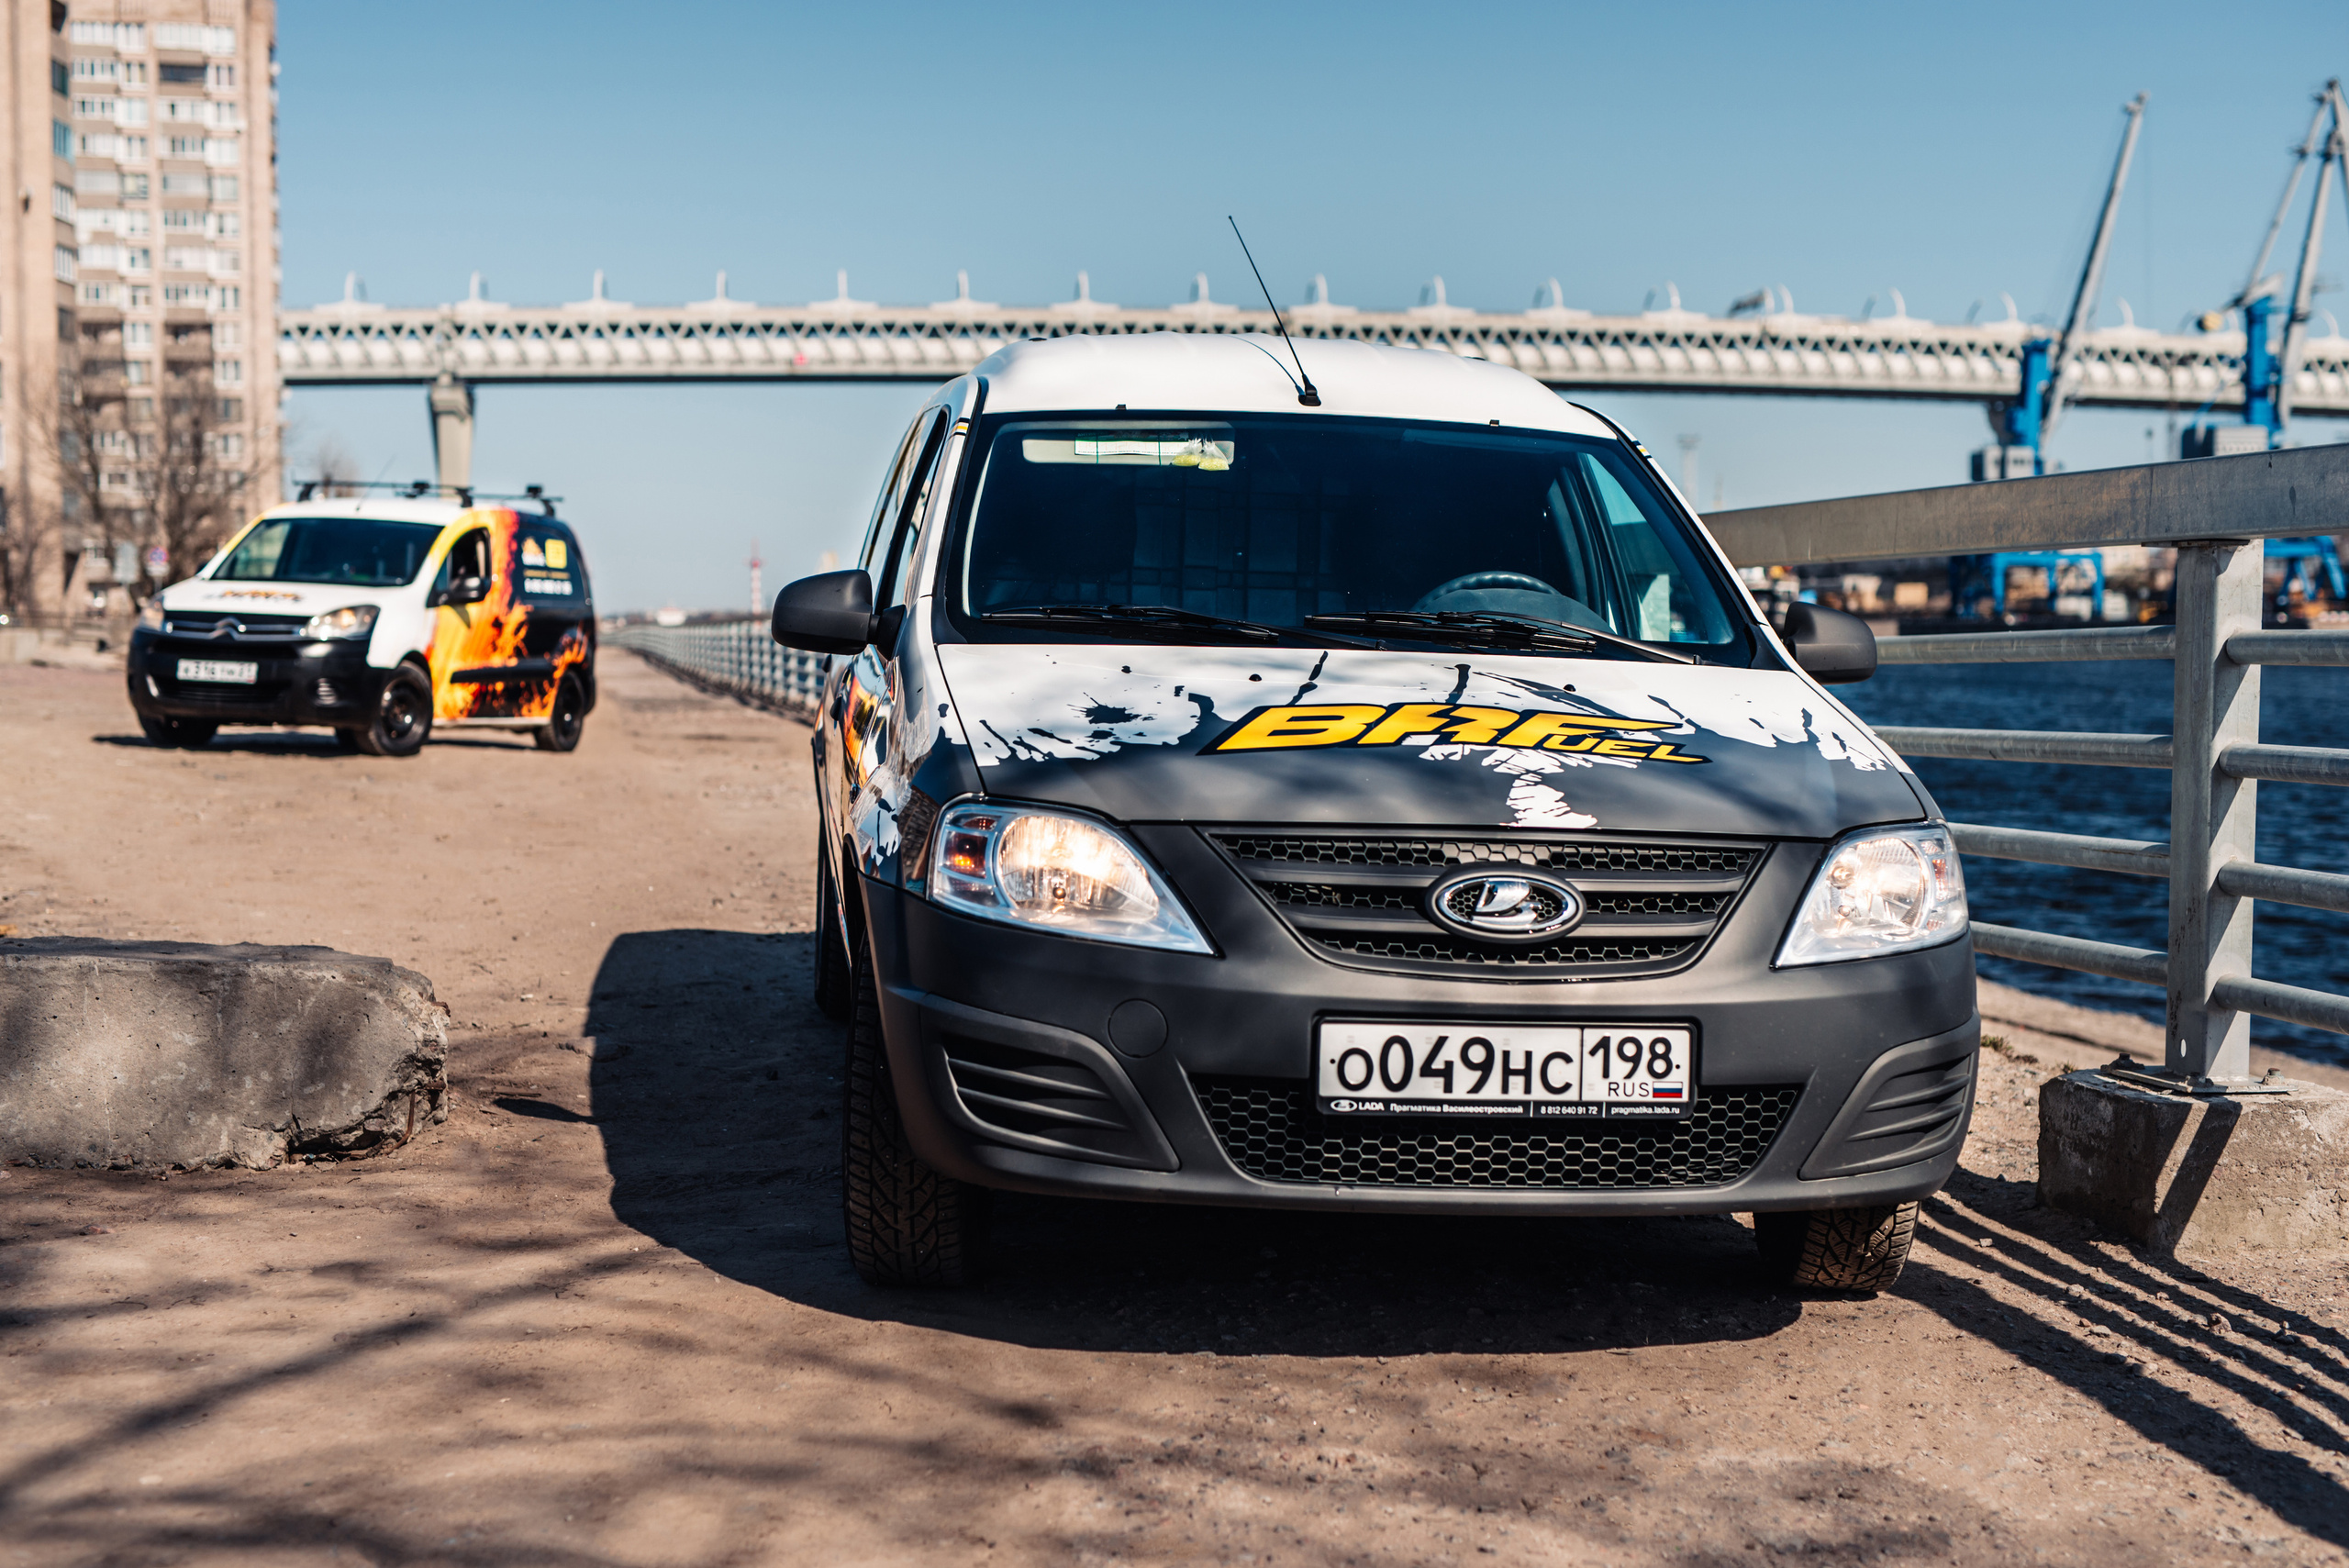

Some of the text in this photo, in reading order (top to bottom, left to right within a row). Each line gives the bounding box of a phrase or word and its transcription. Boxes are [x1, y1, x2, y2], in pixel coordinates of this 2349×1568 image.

[1588, 1035, 1674, 1080] 198
[1608, 1081, 1650, 1097] RUS
[1358, 1101, 1385, 1111] LADA
[1389, 1103, 1523, 1115] Прагматика Василеостровский
[1610, 1106, 1680, 1116] pragmatika.lada.ru
